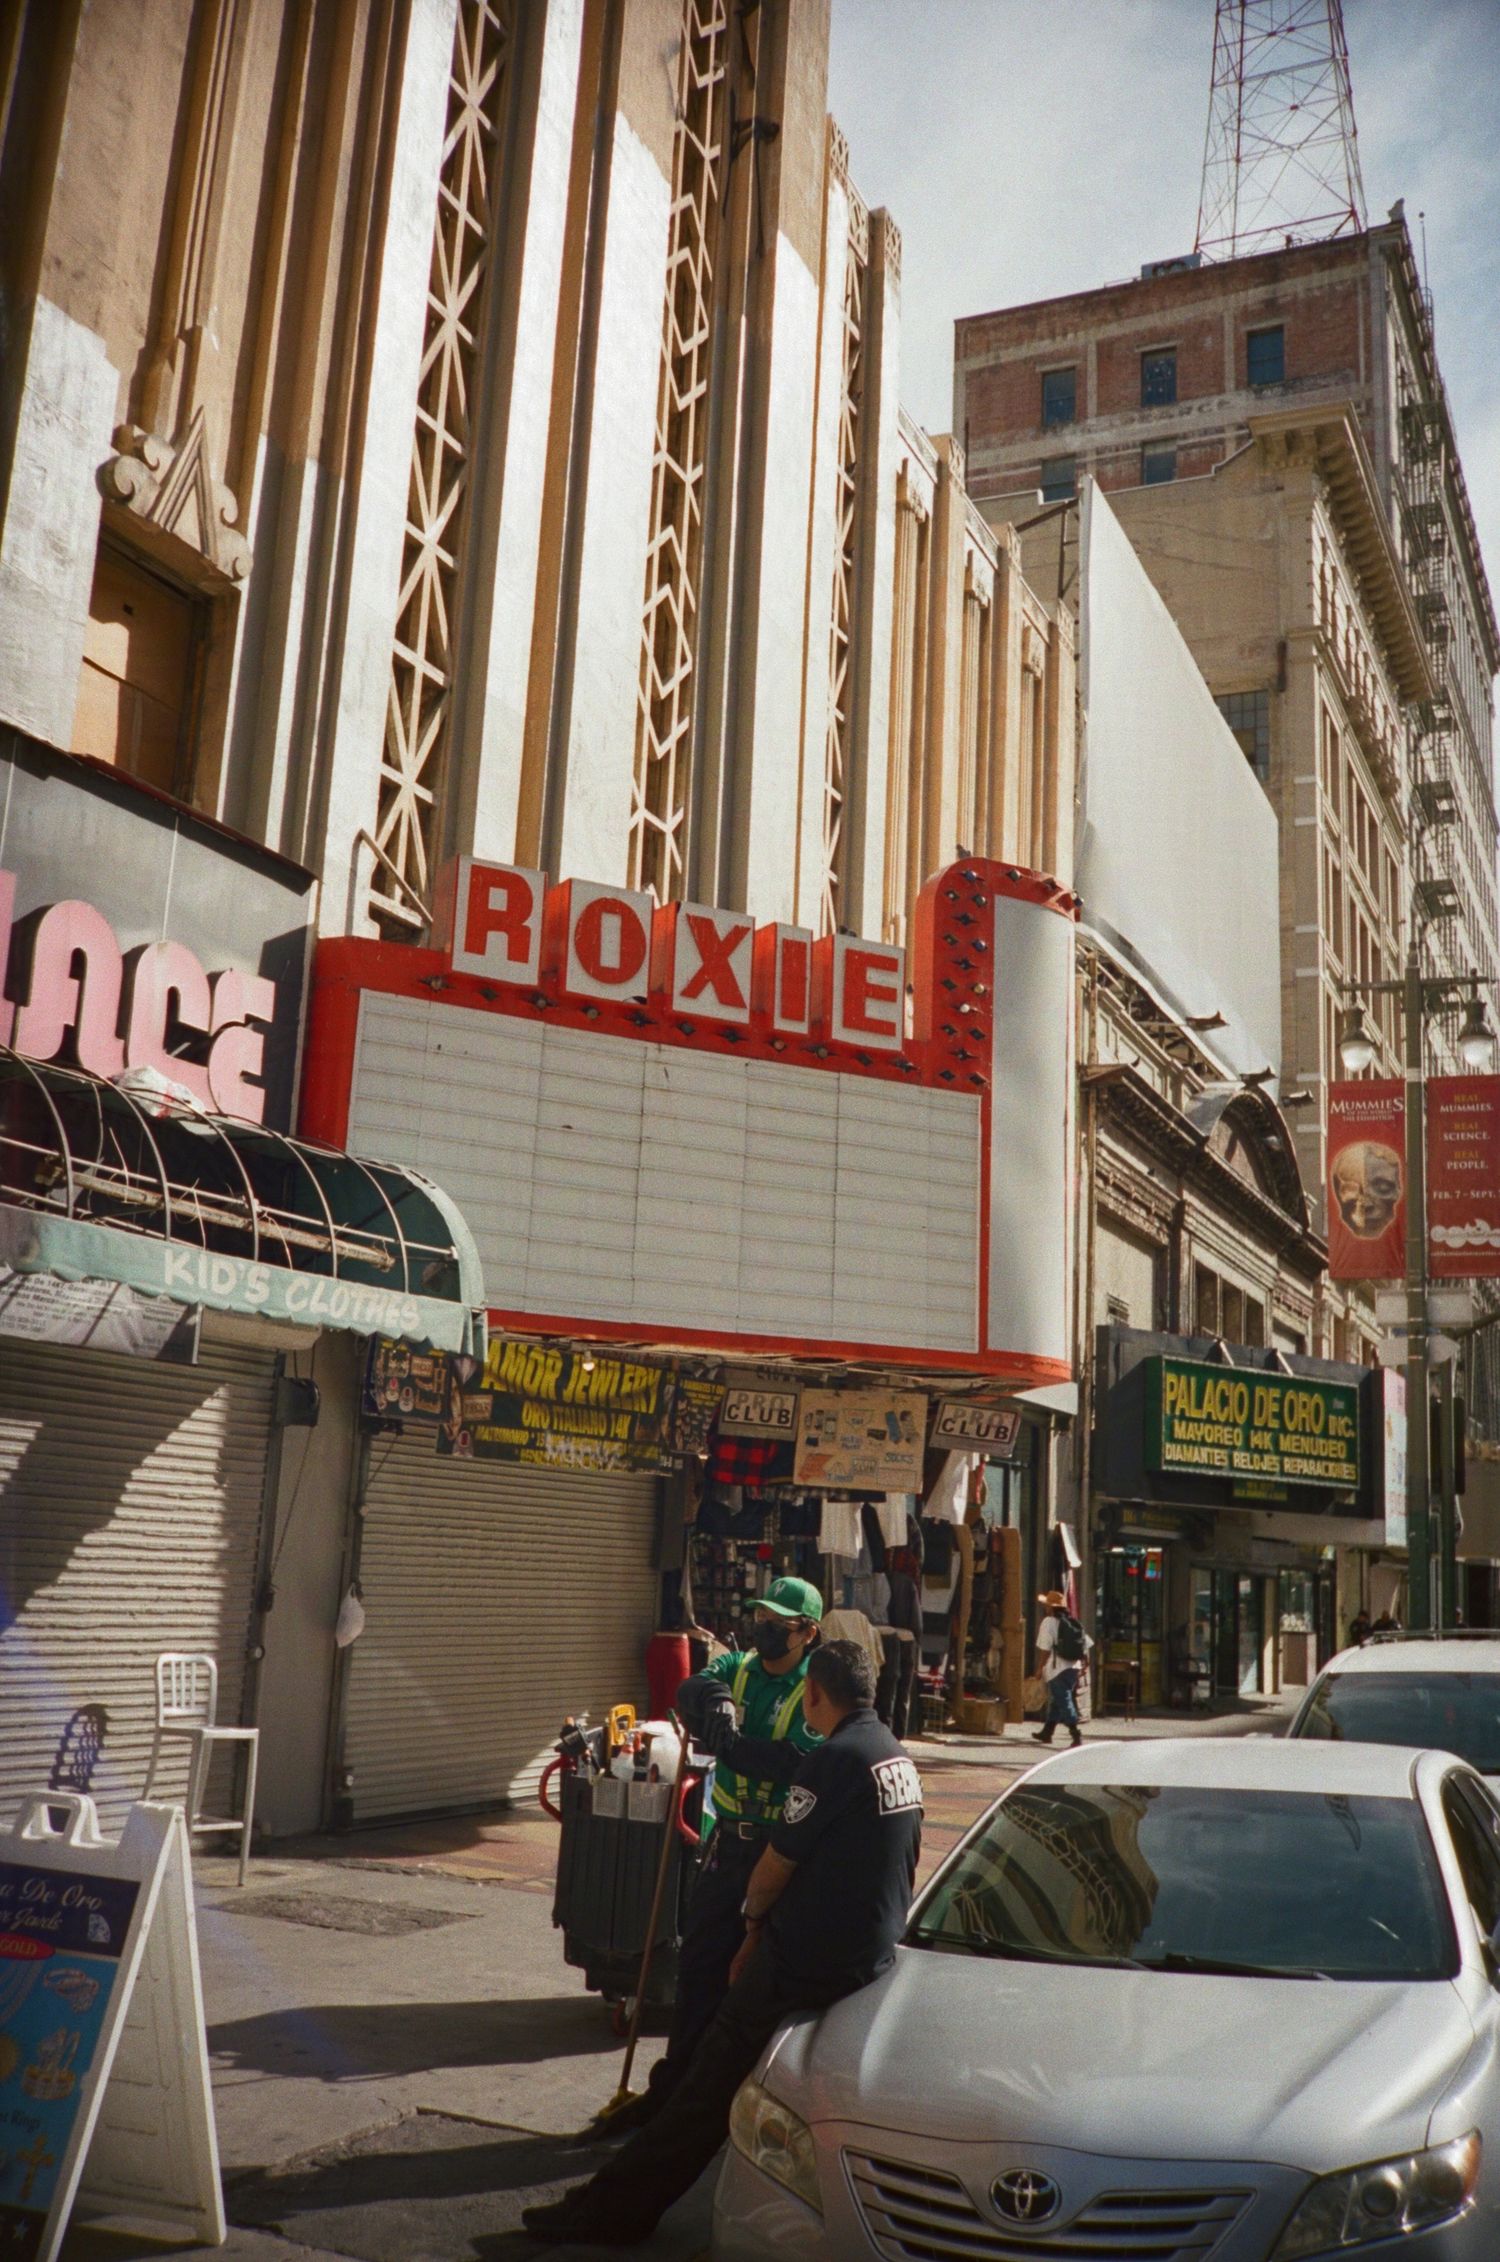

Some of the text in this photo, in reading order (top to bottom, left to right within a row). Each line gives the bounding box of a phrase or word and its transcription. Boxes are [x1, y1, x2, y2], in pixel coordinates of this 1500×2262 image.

[464, 863, 899, 1037] ROXIE
[1330, 1097, 1404, 1115] MUMMIES
[1440, 1103, 1494, 1113] MUMMIES.
[1443, 1131, 1491, 1141] SCIENCE.
[1446, 1160, 1489, 1170] PEOPLE.
[164, 1249, 271, 1304] KID'S
[285, 1279, 420, 1330] CLOTHES
[737, 1392, 786, 1411] PRO
[1165, 1372, 1249, 1425] PALACIO
[1254, 1385, 1281, 1429] DE
[1283, 1389, 1326, 1435] ORO
[727, 1404, 791, 1425] CLUB
[953, 1407, 1004, 1427] PRO
[942, 1418, 1009, 1440] CLUB
[1173, 1419, 1243, 1446] MAYOREO
[1279, 1433, 1347, 1459] MENUDEO
[1165, 1443, 1357, 1480] DIAMANTES RELOJES REPARACIONES
[61, 1883, 103, 1911] Oro
